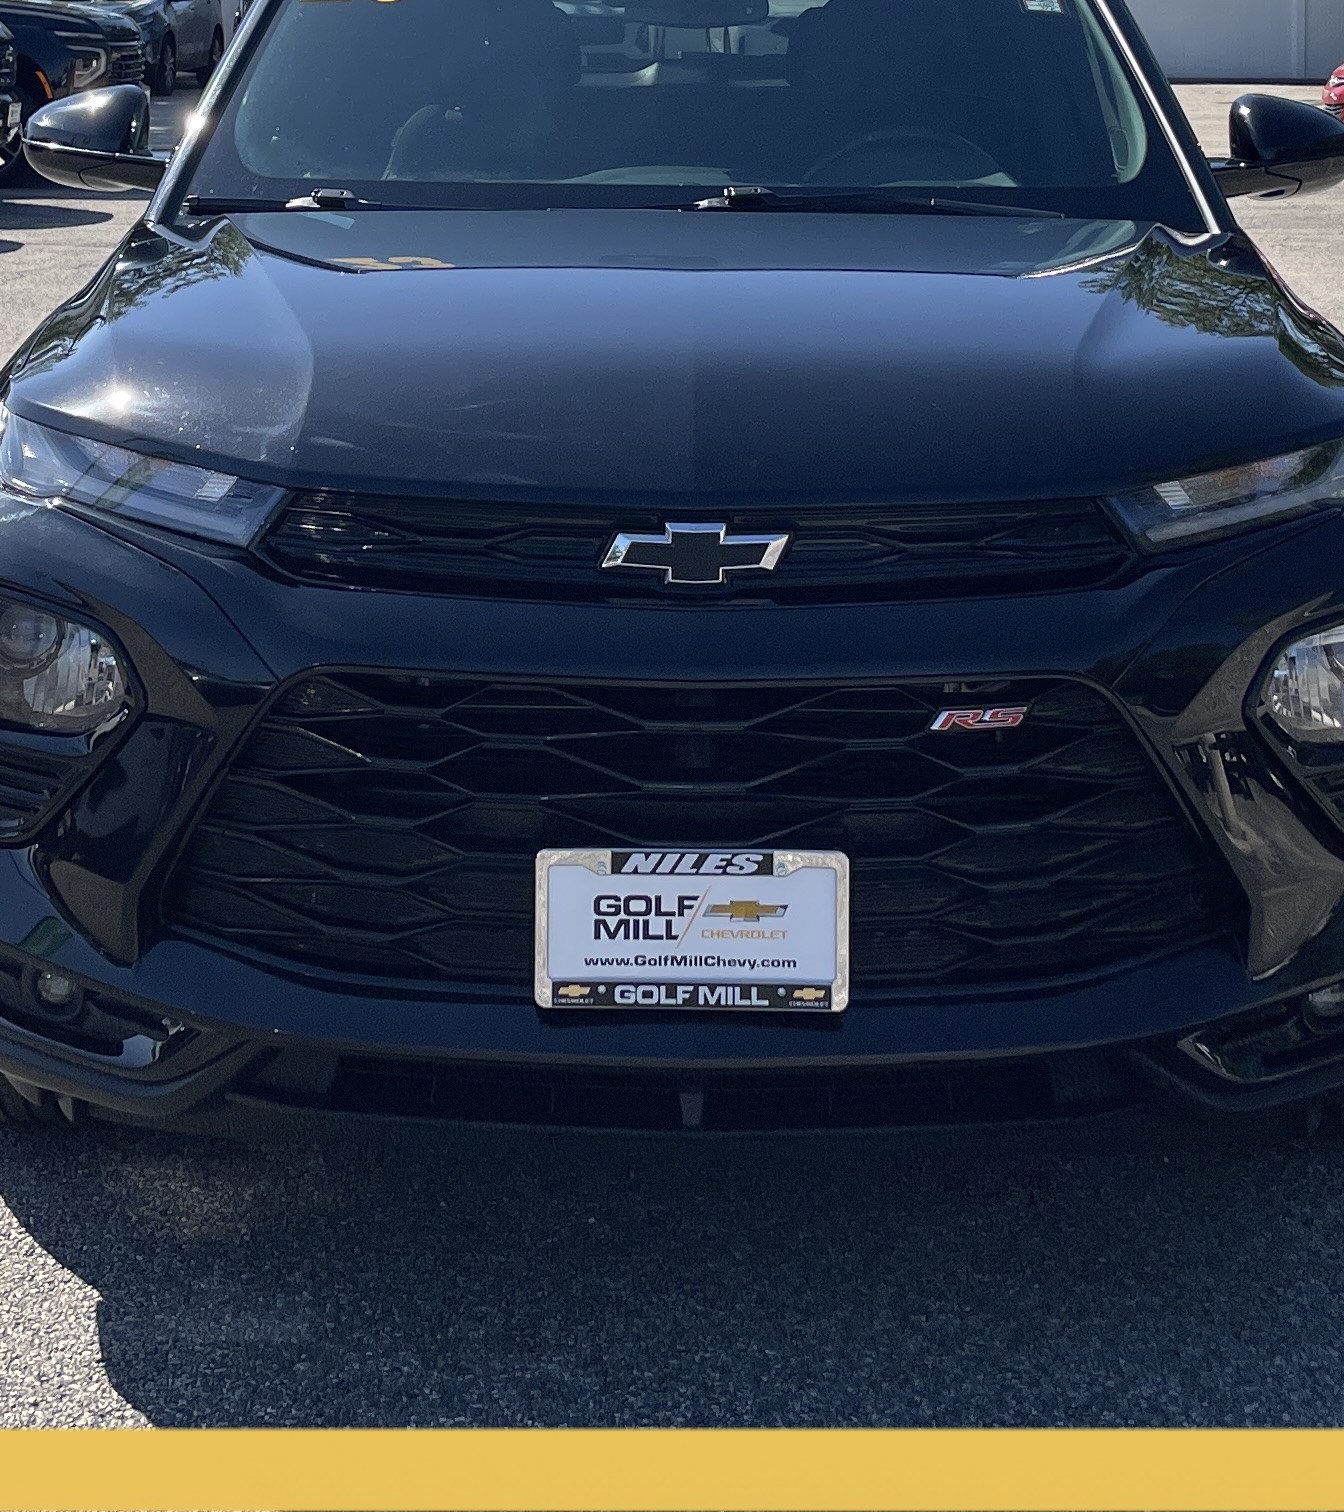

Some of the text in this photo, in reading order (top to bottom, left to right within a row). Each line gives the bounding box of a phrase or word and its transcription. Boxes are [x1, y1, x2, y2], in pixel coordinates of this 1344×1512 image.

[929, 696, 1028, 731] RS
[620, 852, 764, 875] NILES
[593, 894, 701, 917] GOLF
[593, 918, 680, 940] MILL
[701, 929, 789, 941] CHEVROLET
[584, 955, 798, 970] www.GolfMillChevy.com
[614, 984, 770, 1006] GOLF MILL
